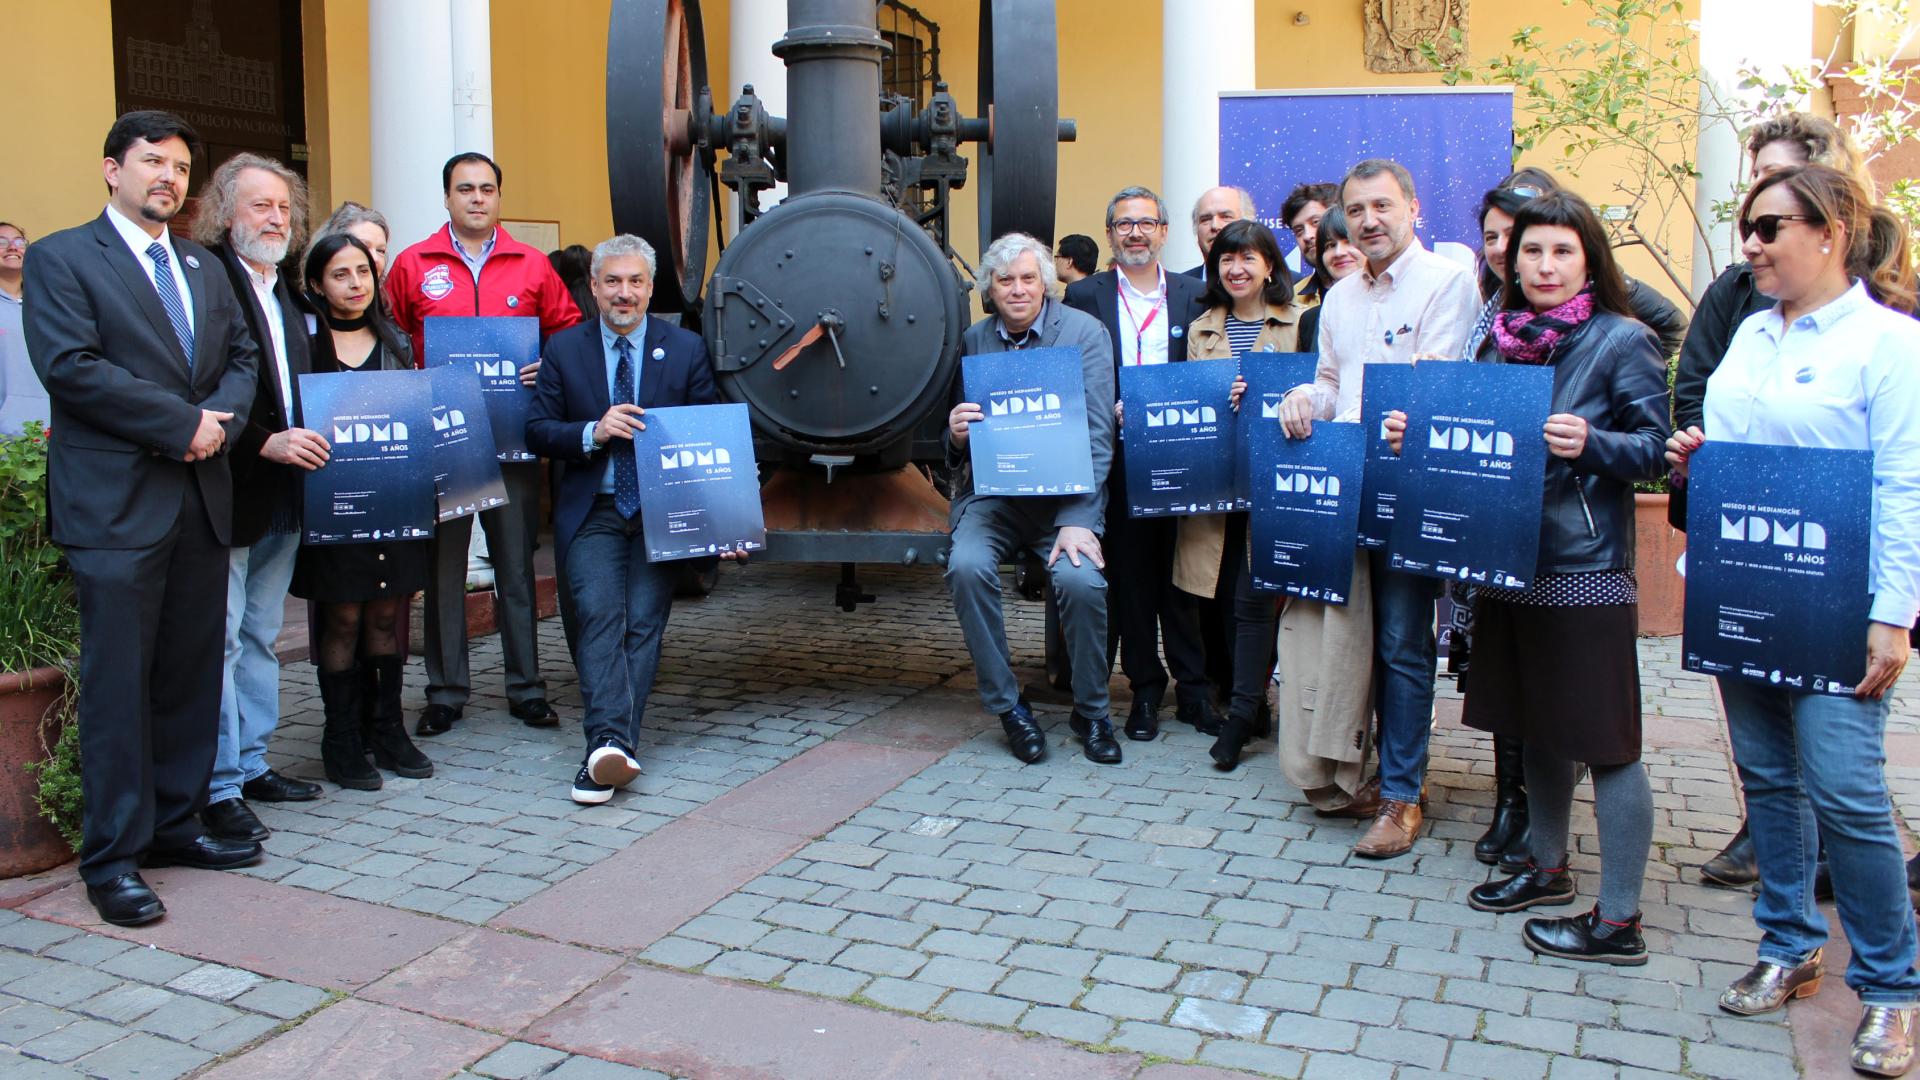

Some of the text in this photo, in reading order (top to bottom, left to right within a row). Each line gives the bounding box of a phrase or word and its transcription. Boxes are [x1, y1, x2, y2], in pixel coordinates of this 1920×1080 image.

[181, 110, 293, 136] TÓRICO NACIONAL
[1721, 502, 1747, 510] MUSEOS
[1757, 506, 1801, 516] MEDIANOCHE
